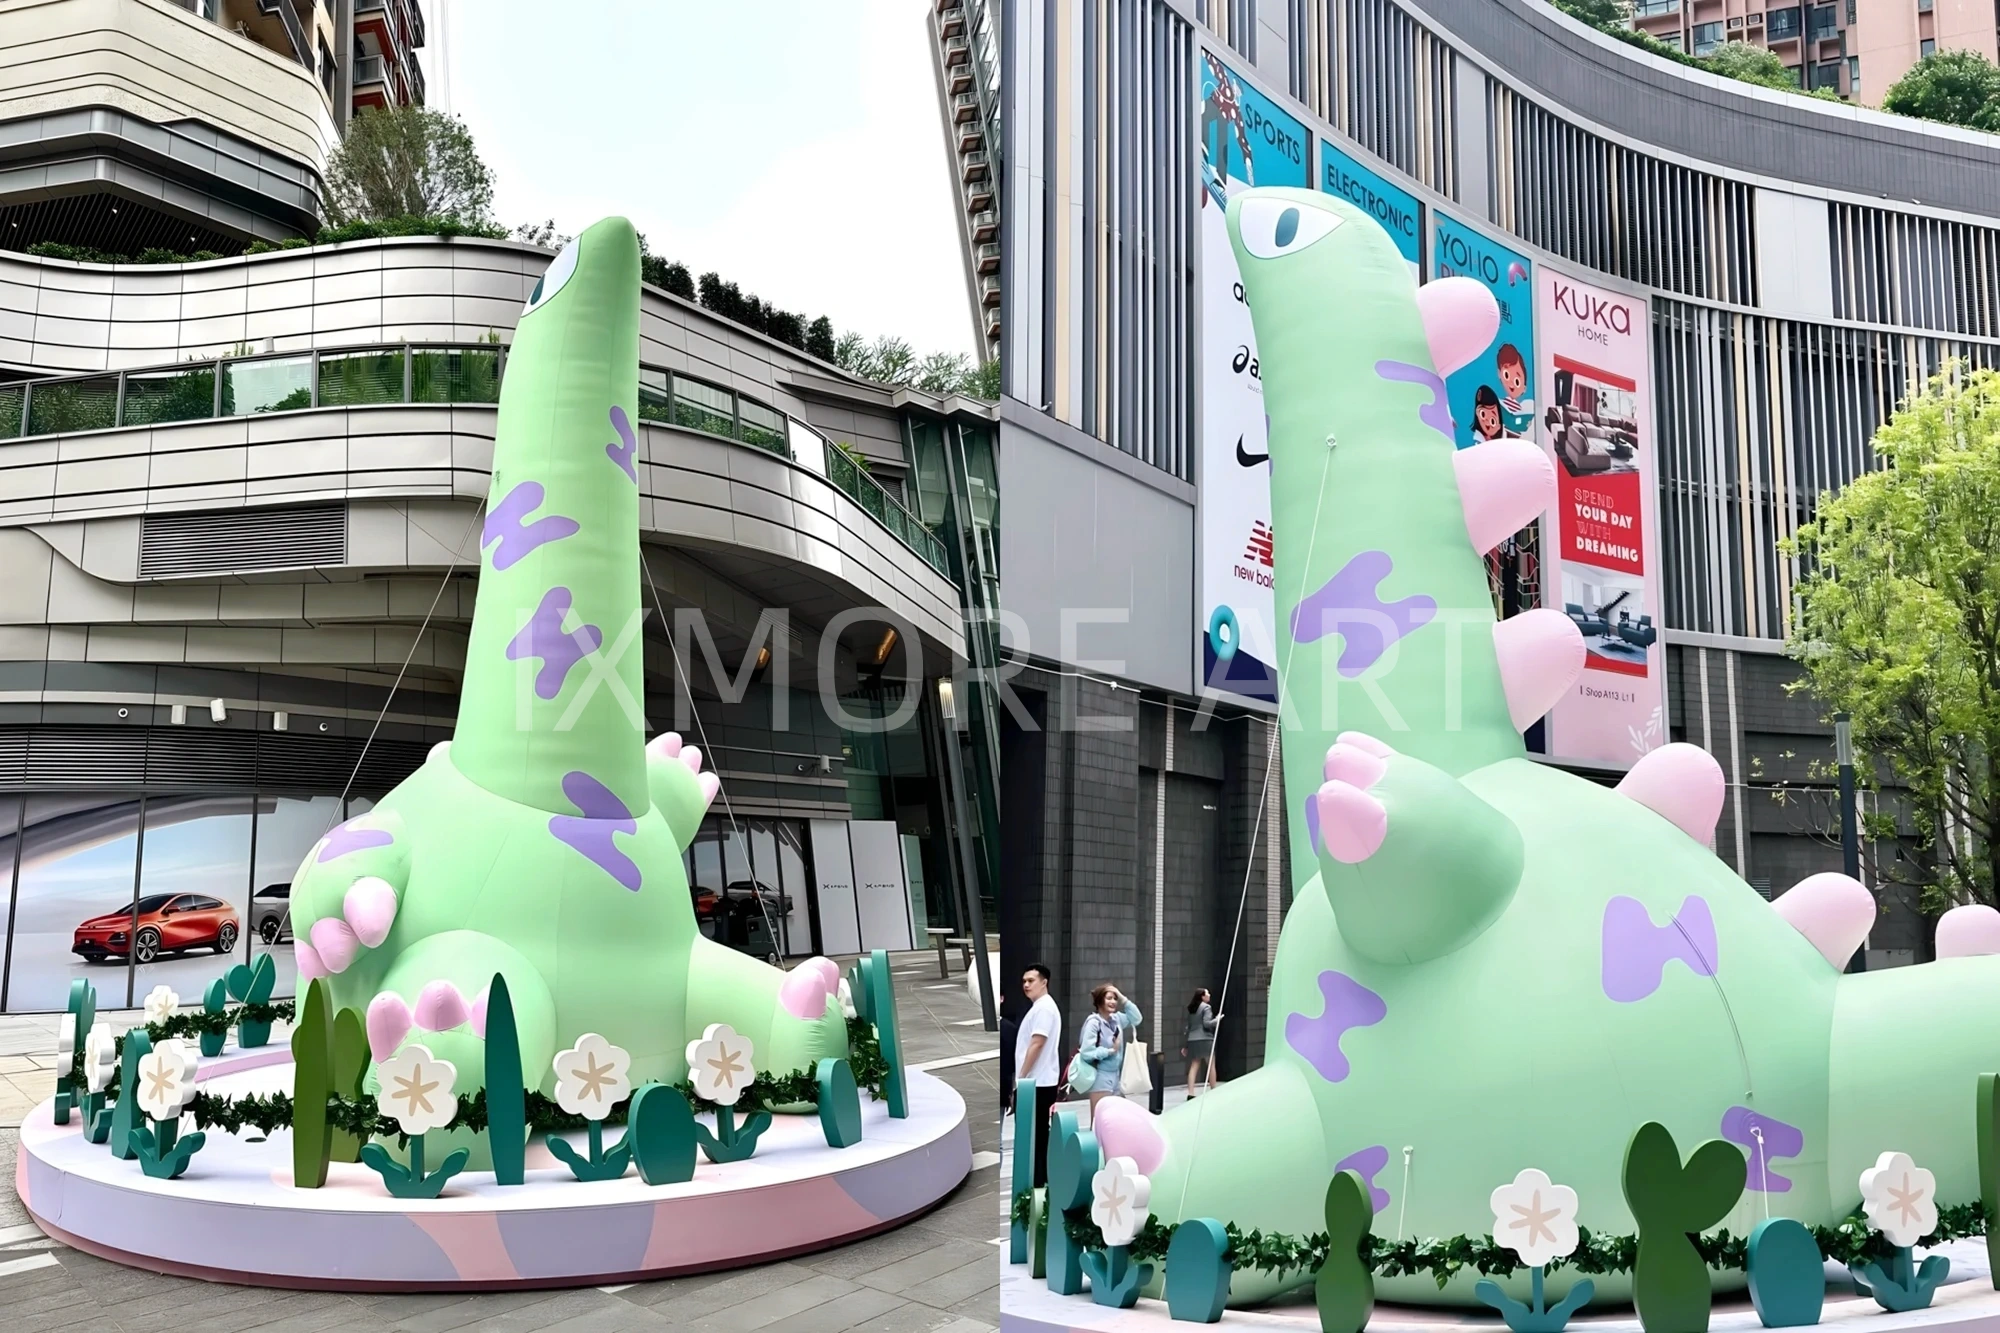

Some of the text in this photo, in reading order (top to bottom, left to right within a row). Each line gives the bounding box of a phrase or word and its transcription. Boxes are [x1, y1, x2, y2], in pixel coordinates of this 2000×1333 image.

[1245, 104, 1301, 165] SPORTS
[1327, 163, 1414, 237] ELECTRONIC
[1577, 325, 1609, 346] HOME
[1574, 487, 1614, 509] SPEND
[1574, 503, 1633, 529] YOUR DAY
[1576, 520, 1611, 540] WITH
[1576, 536, 1639, 562] DREAMING
[1234, 564, 1255, 582] new
[1585, 686, 1603, 699] Shop
